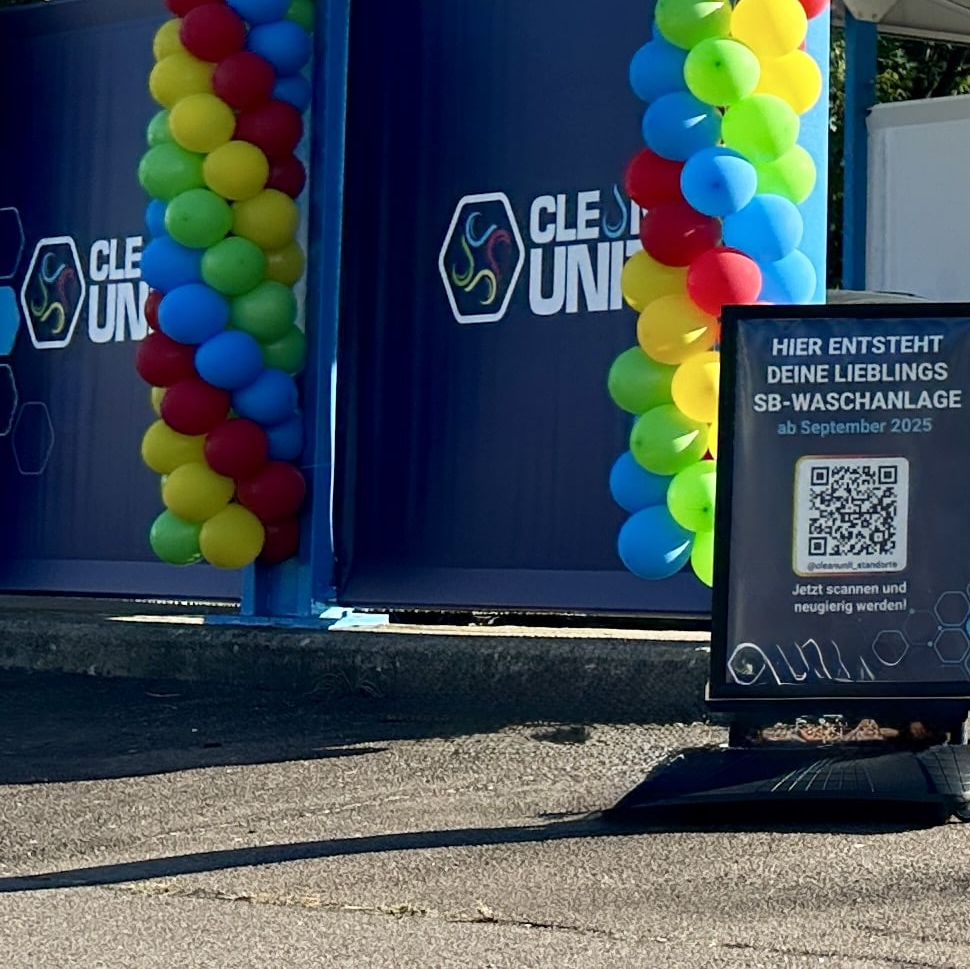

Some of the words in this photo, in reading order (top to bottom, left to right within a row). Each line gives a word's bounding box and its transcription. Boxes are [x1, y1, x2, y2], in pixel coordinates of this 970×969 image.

[772, 338, 822, 356] HIER
[828, 335, 944, 355] ENTSTEHT
[767, 364, 829, 384] DEINE
[834, 362, 949, 383] LIEBLINGS
[753, 390, 962, 412] SB-WASCHANLAGE
[777, 420, 796, 435] ab
[801, 418, 887, 438] September
[890, 418, 933, 433] 2025
[792, 583, 823, 596] Jetzt
[826, 584, 879, 595] scannen
[882, 581, 907, 594] und
[794, 600, 853, 615] neugierig
[855, 598, 907, 611] werden!
